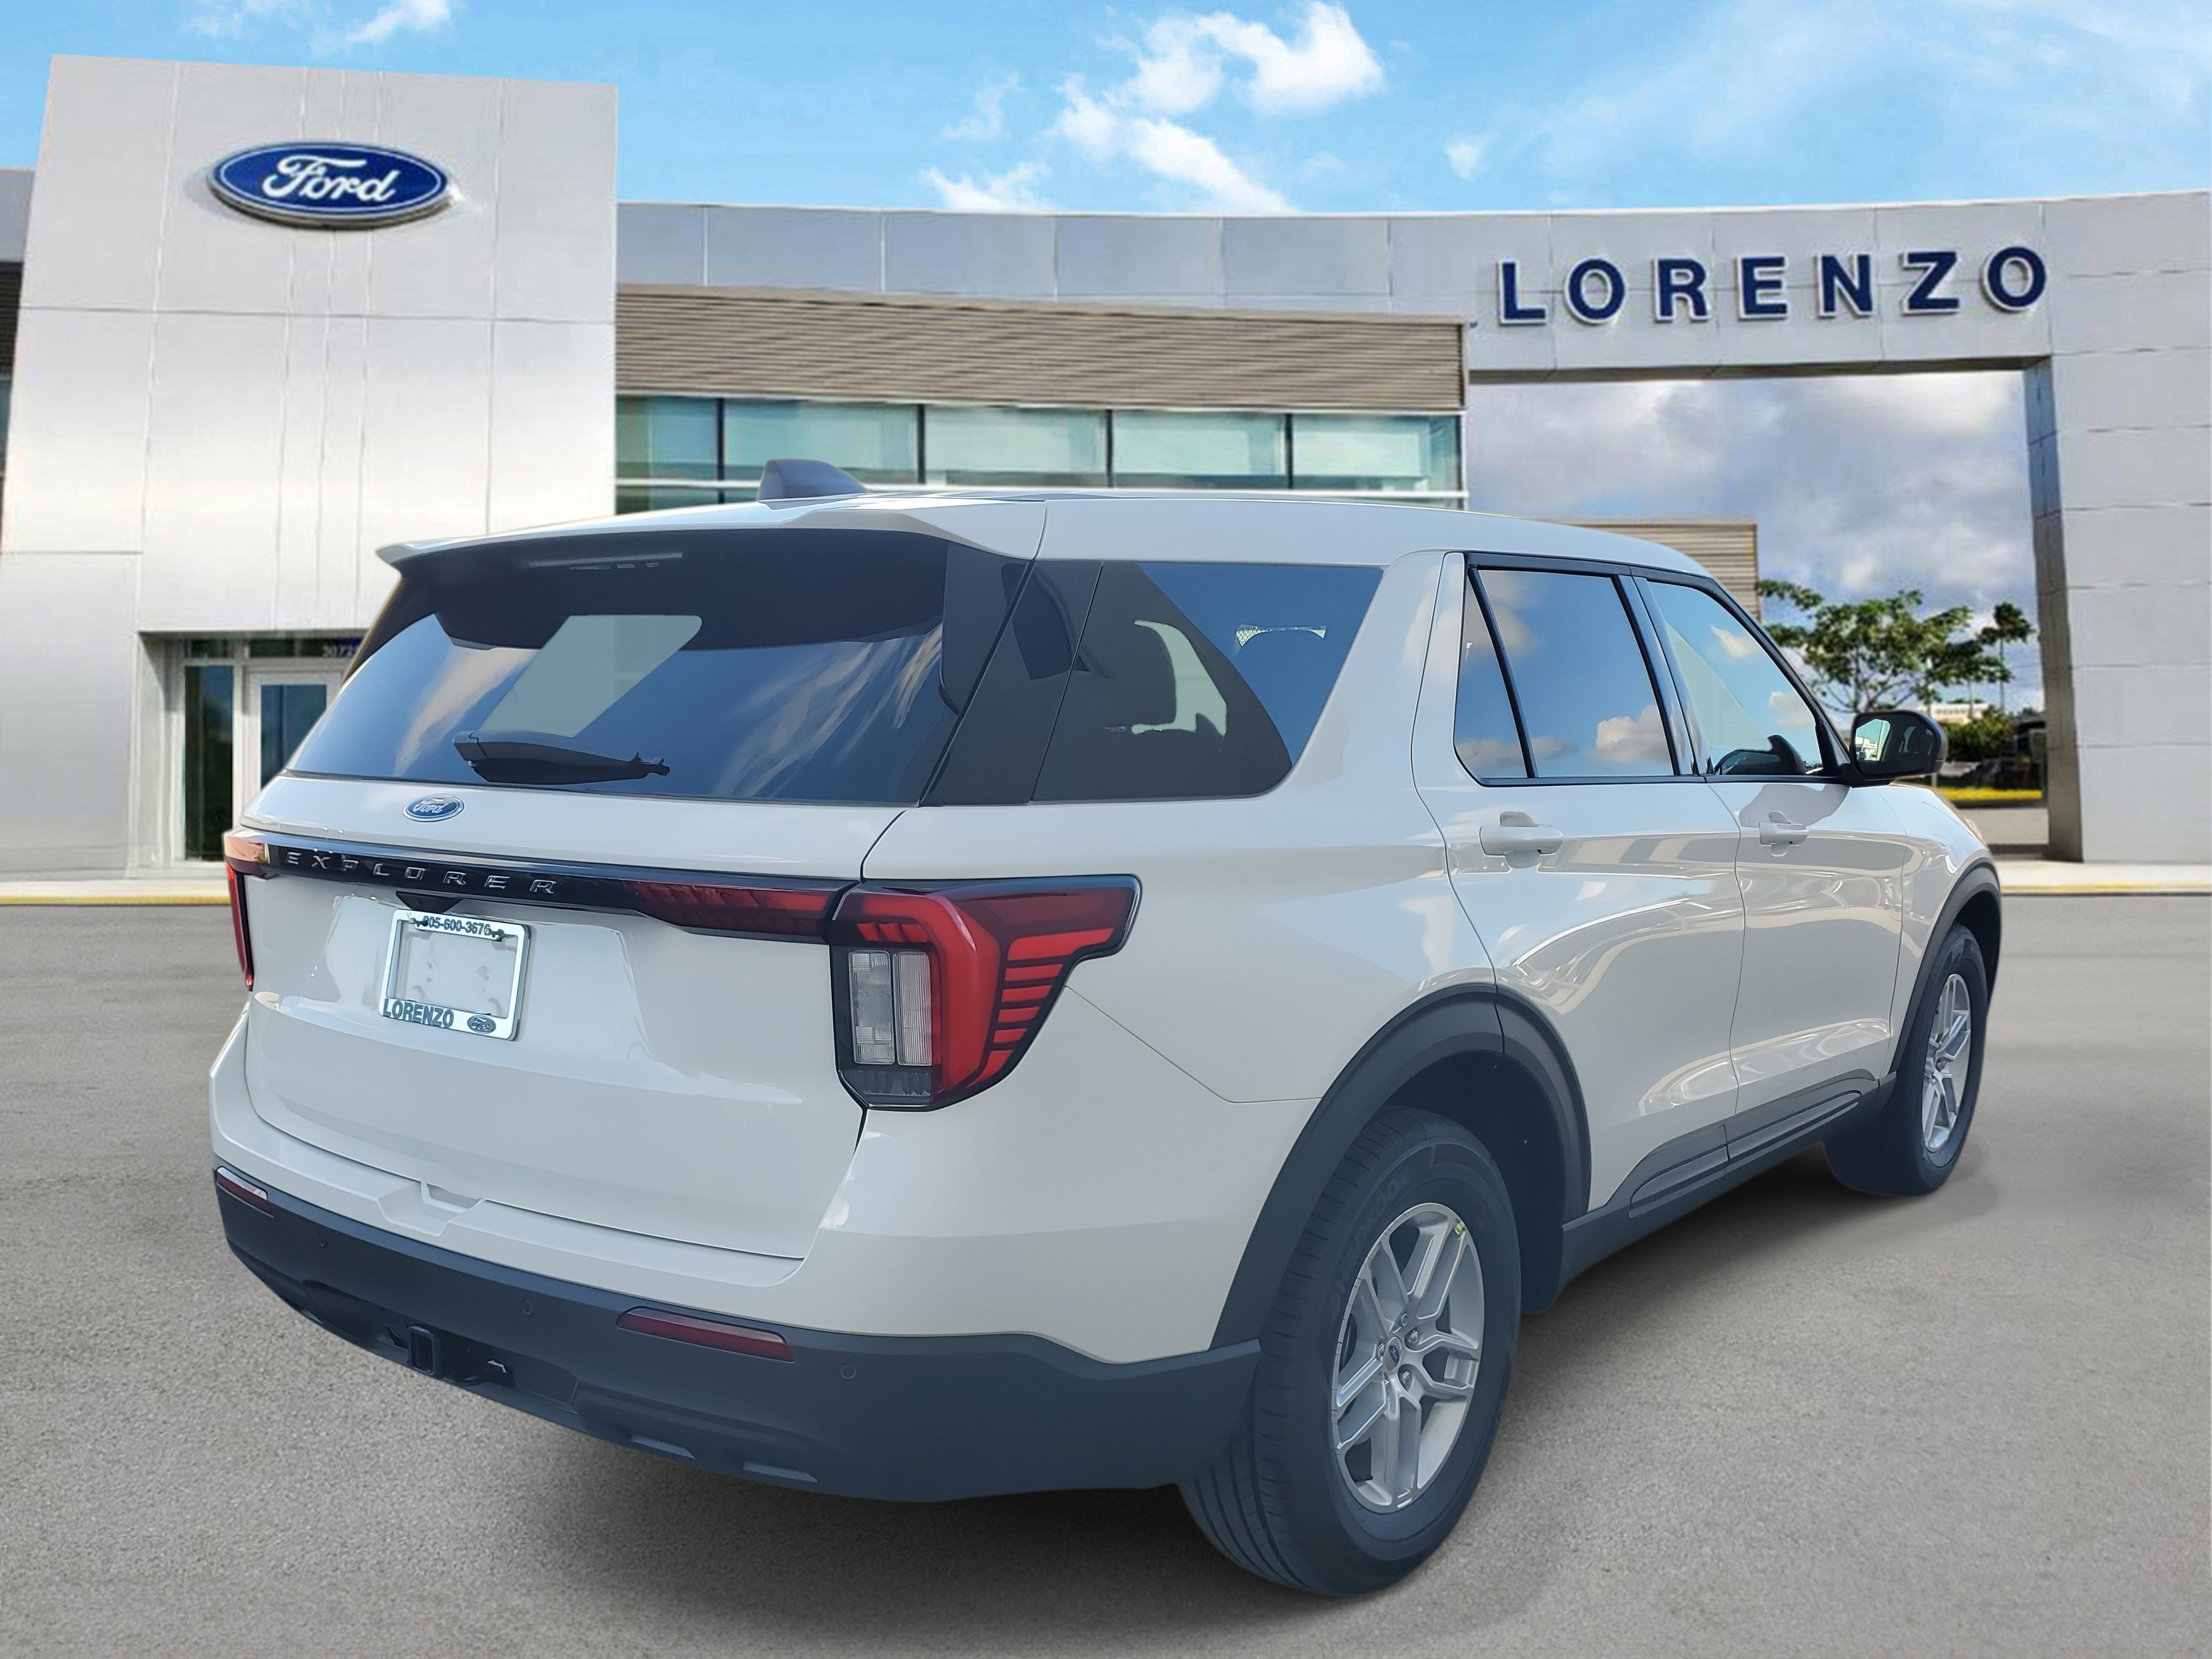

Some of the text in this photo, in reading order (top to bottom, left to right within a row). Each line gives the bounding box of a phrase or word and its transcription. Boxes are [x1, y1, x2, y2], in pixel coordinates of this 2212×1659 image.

[262, 154, 400, 202] Ford
[1499, 245, 2048, 325] LORENZO
[286, 852, 557, 894] EXPLORER
[383, 998, 454, 1029] LORENZO
